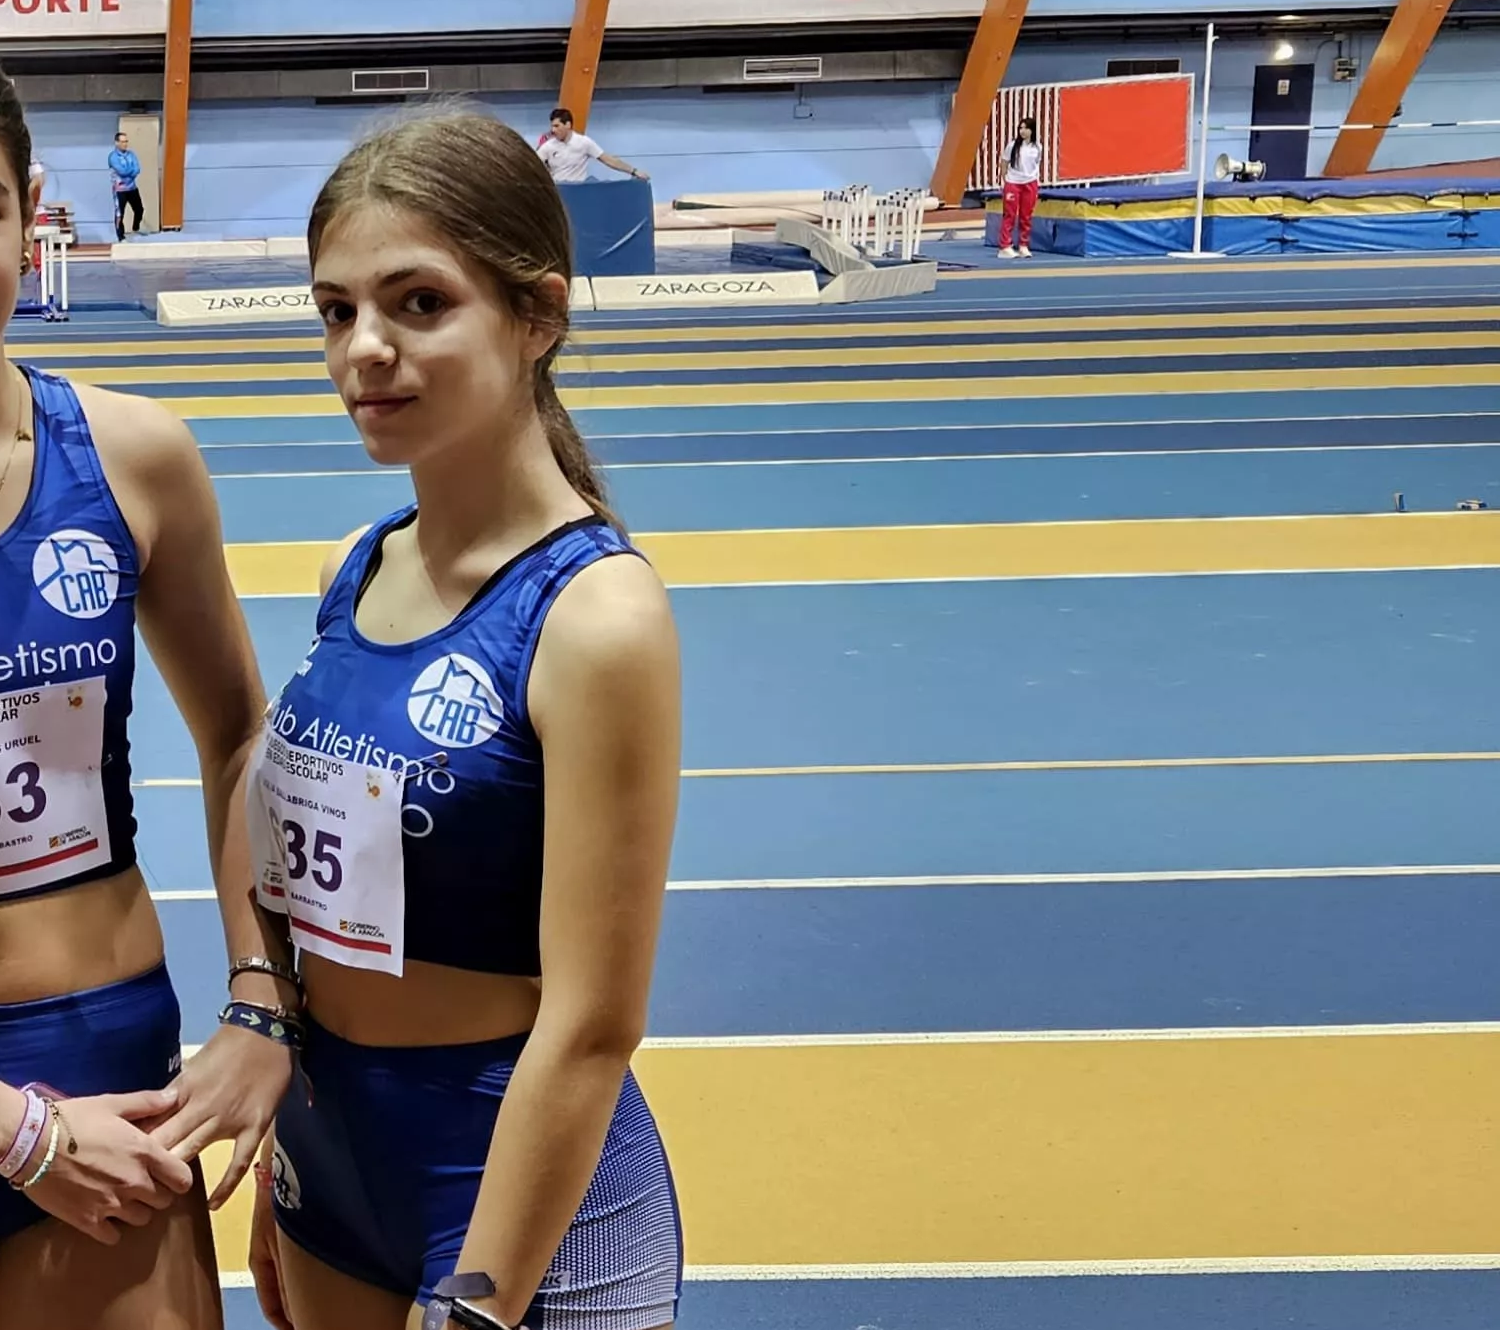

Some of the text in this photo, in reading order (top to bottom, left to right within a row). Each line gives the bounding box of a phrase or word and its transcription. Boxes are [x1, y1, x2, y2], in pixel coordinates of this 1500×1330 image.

[637, 280, 775, 297] ZARAGOZA
[202, 294, 314, 311] ZARAGOZ
[60, 570, 108, 613] CAB
[420, 691, 481, 745] CAB
[4, 734, 42, 751] URUEL
[286, 749, 344, 776] EPORTIVOS
[299, 717, 456, 794] Atletismo
[285, 763, 329, 784] ESCOLAR
[321, 803, 347, 820] VINOS
